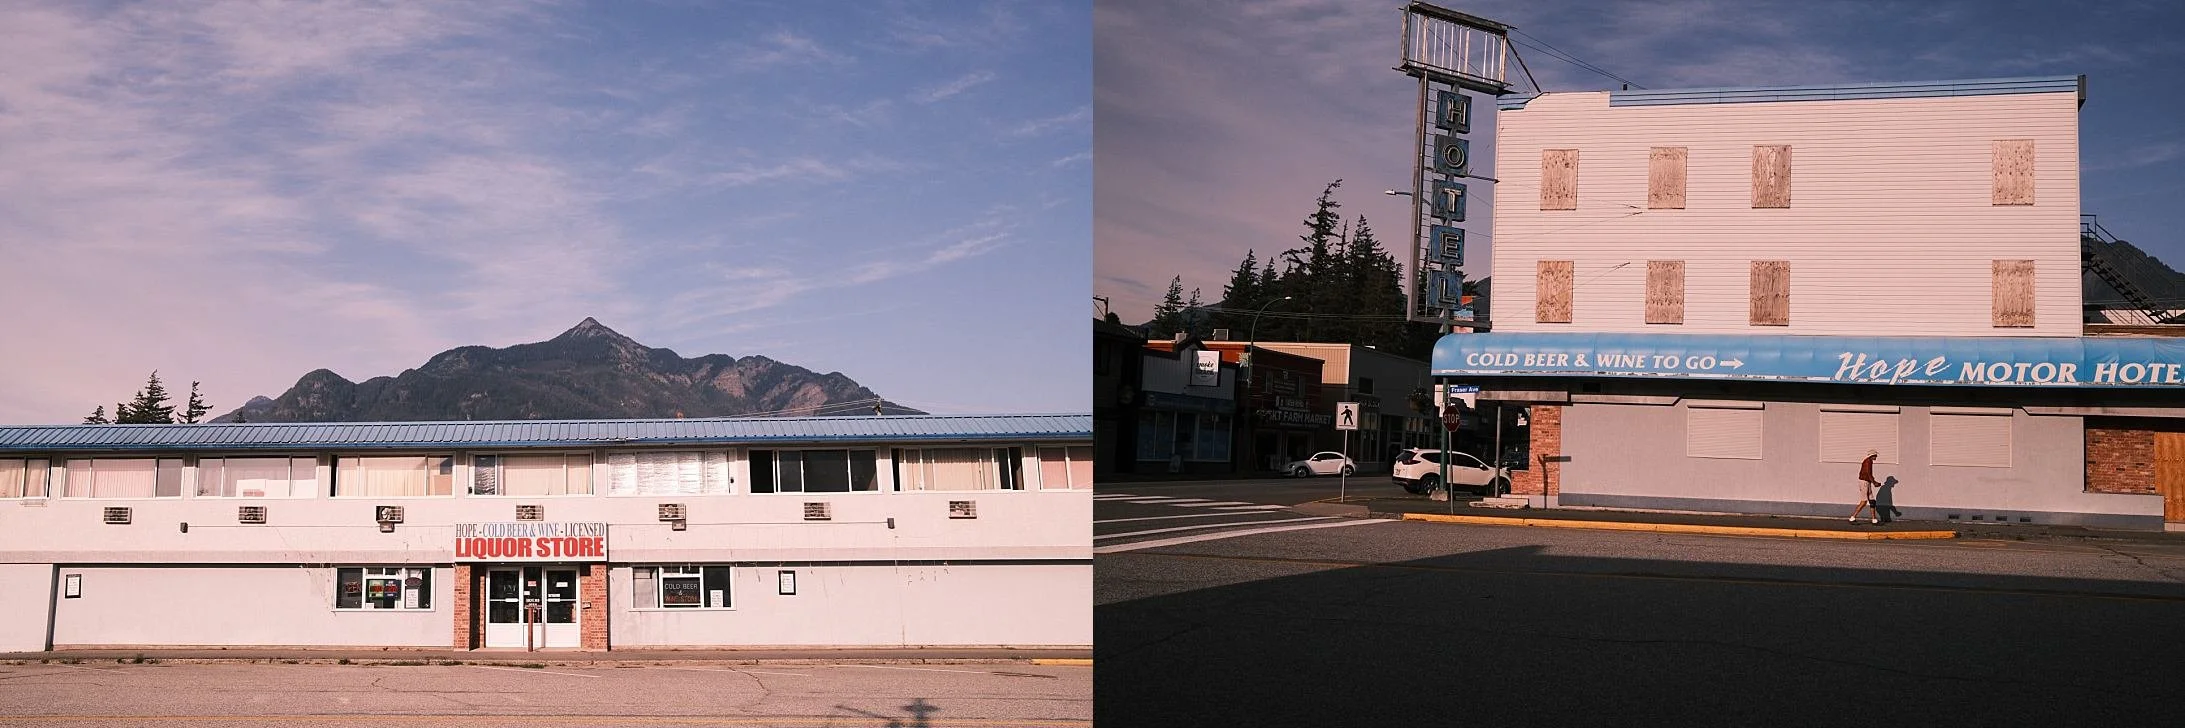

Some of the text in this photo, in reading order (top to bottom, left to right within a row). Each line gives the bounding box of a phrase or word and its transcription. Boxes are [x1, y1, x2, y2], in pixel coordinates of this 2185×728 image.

[1438, 97, 1467, 303] HOTEL
[1466, 352, 1716, 370] COLD BEER & WINE TO GO
[1834, 351, 2185, 384] Hope MOTOR HOTE
[1305, 412, 1332, 425] MARKET
[1443, 413, 1460, 424] STOP
[455, 523, 478, 537] HOPE
[482, 523, 505, 537] COLD
[507, 523, 529, 537] BEER
[529, 523, 536, 537] &
[538, 523, 560, 537] WINE
[565, 522, 605, 537] LICENSED
[455, 538, 604, 559] LIQUOR STORE
